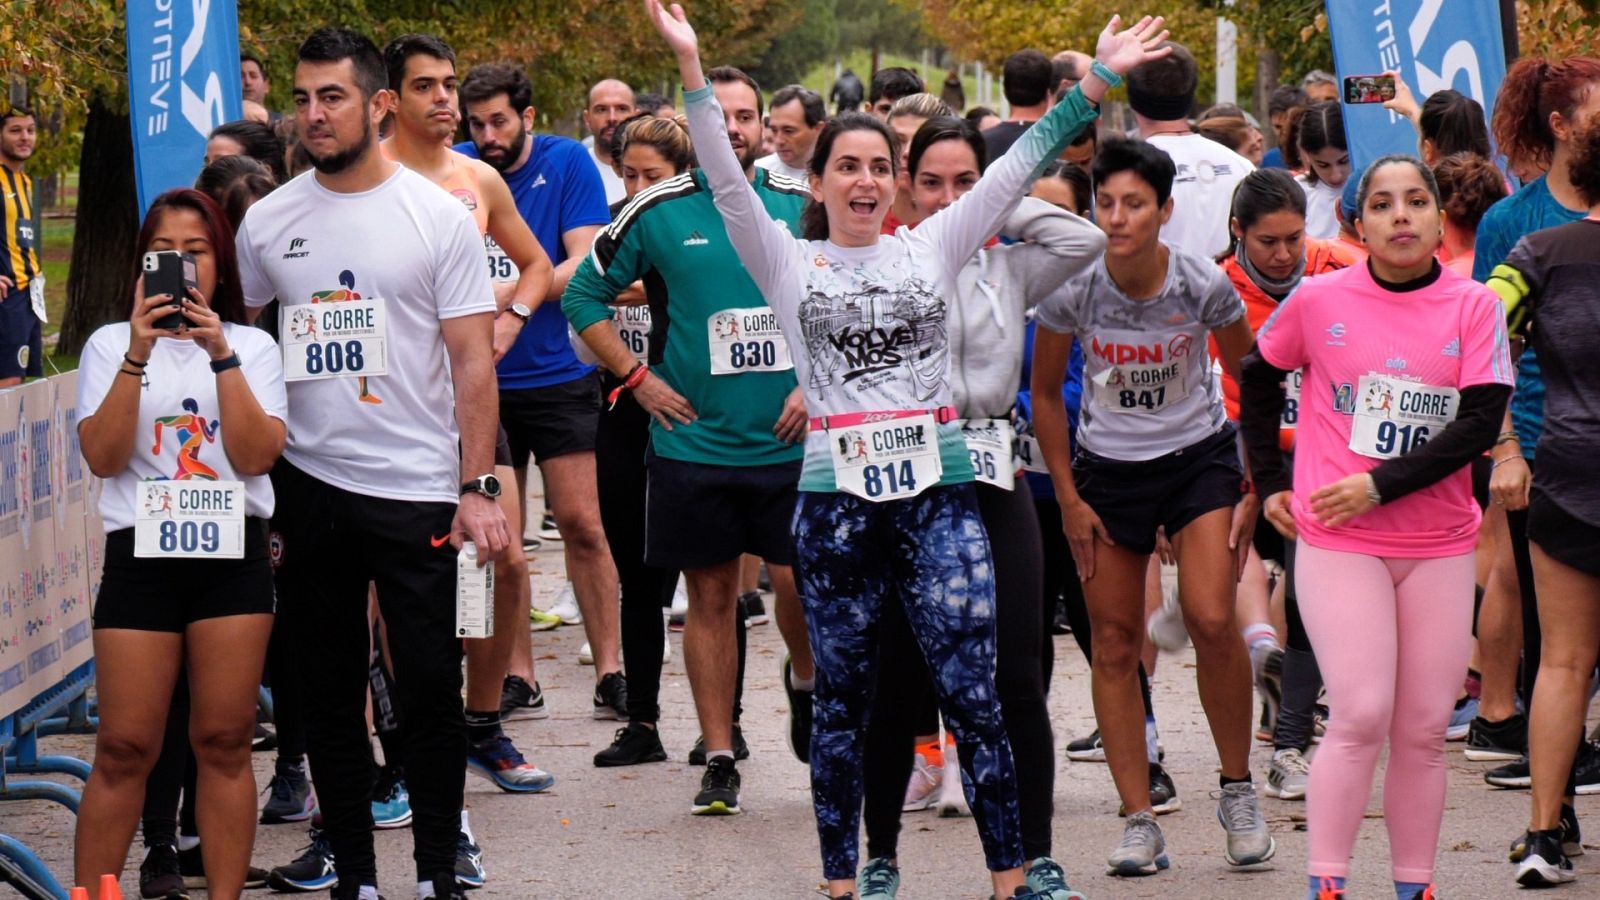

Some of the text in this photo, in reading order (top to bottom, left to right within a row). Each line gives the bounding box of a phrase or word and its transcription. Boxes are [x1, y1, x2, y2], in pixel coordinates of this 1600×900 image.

[323, 308, 374, 330] CORRE
[626, 307, 649, 321] COR
[619, 329, 649, 354] 86
[730, 340, 776, 368] 830
[306, 340, 364, 374] 808
[844, 346, 904, 368] MOS
[1131, 362, 1179, 384] CORRE
[1119, 385, 1165, 410] 847
[1399, 390, 1451, 416] CORRE
[1376, 420, 1430, 455] 916
[863, 460, 916, 497] 814
[179, 489, 233, 510] CORRE
[160, 520, 219, 552] 809
